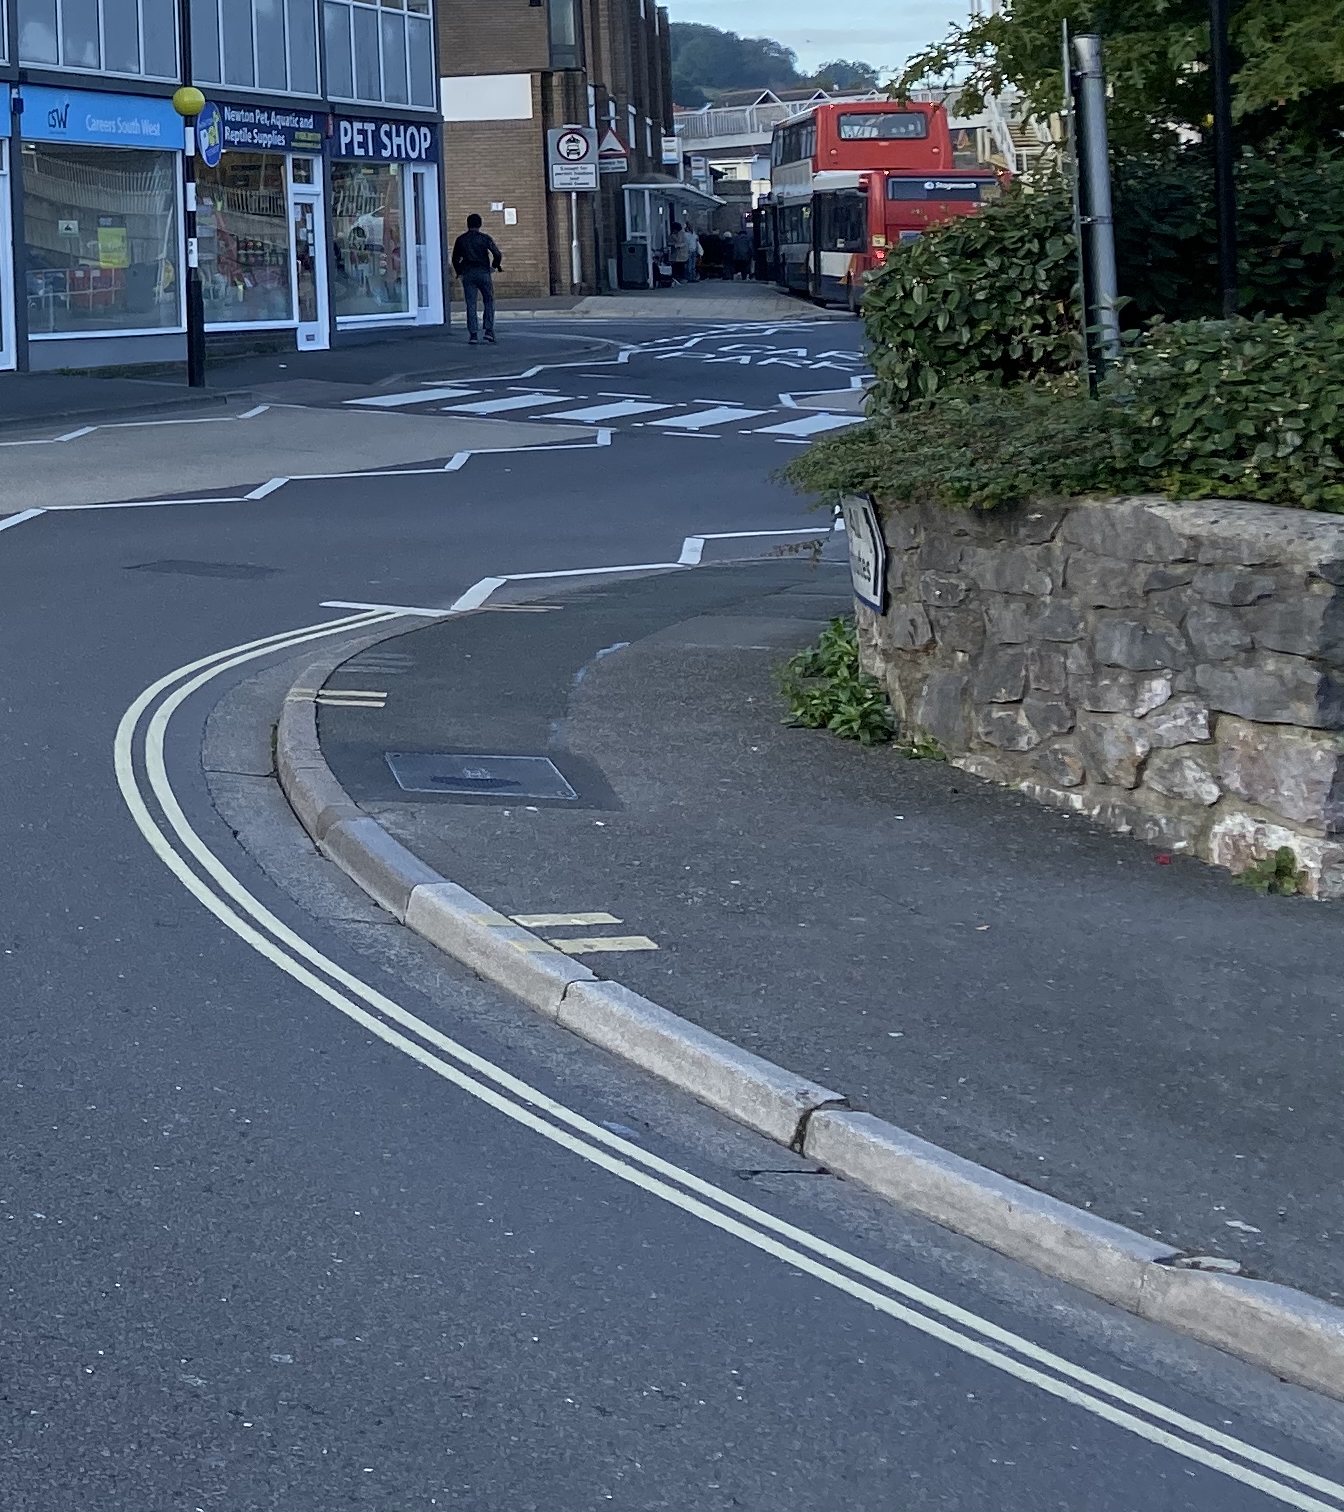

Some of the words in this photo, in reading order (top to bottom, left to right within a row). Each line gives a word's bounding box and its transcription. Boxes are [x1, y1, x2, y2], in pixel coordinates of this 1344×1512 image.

[85, 114, 116, 133] Careers
[117, 117, 141, 135] South
[141, 119, 161, 136] West
[224, 106, 254, 123] Newton
[255, 109, 270, 126] Pet,
[271, 111, 298, 129] Aquatic
[299, 114, 313, 129] and
[225, 126, 252, 145] Reptile
[253, 128, 286, 148] Supplies
[339, 120, 375, 157] PET
[380, 123, 431, 159] SHOP
[654, 351, 865, 371] PARK
[717, 343, 868, 361] CAR
